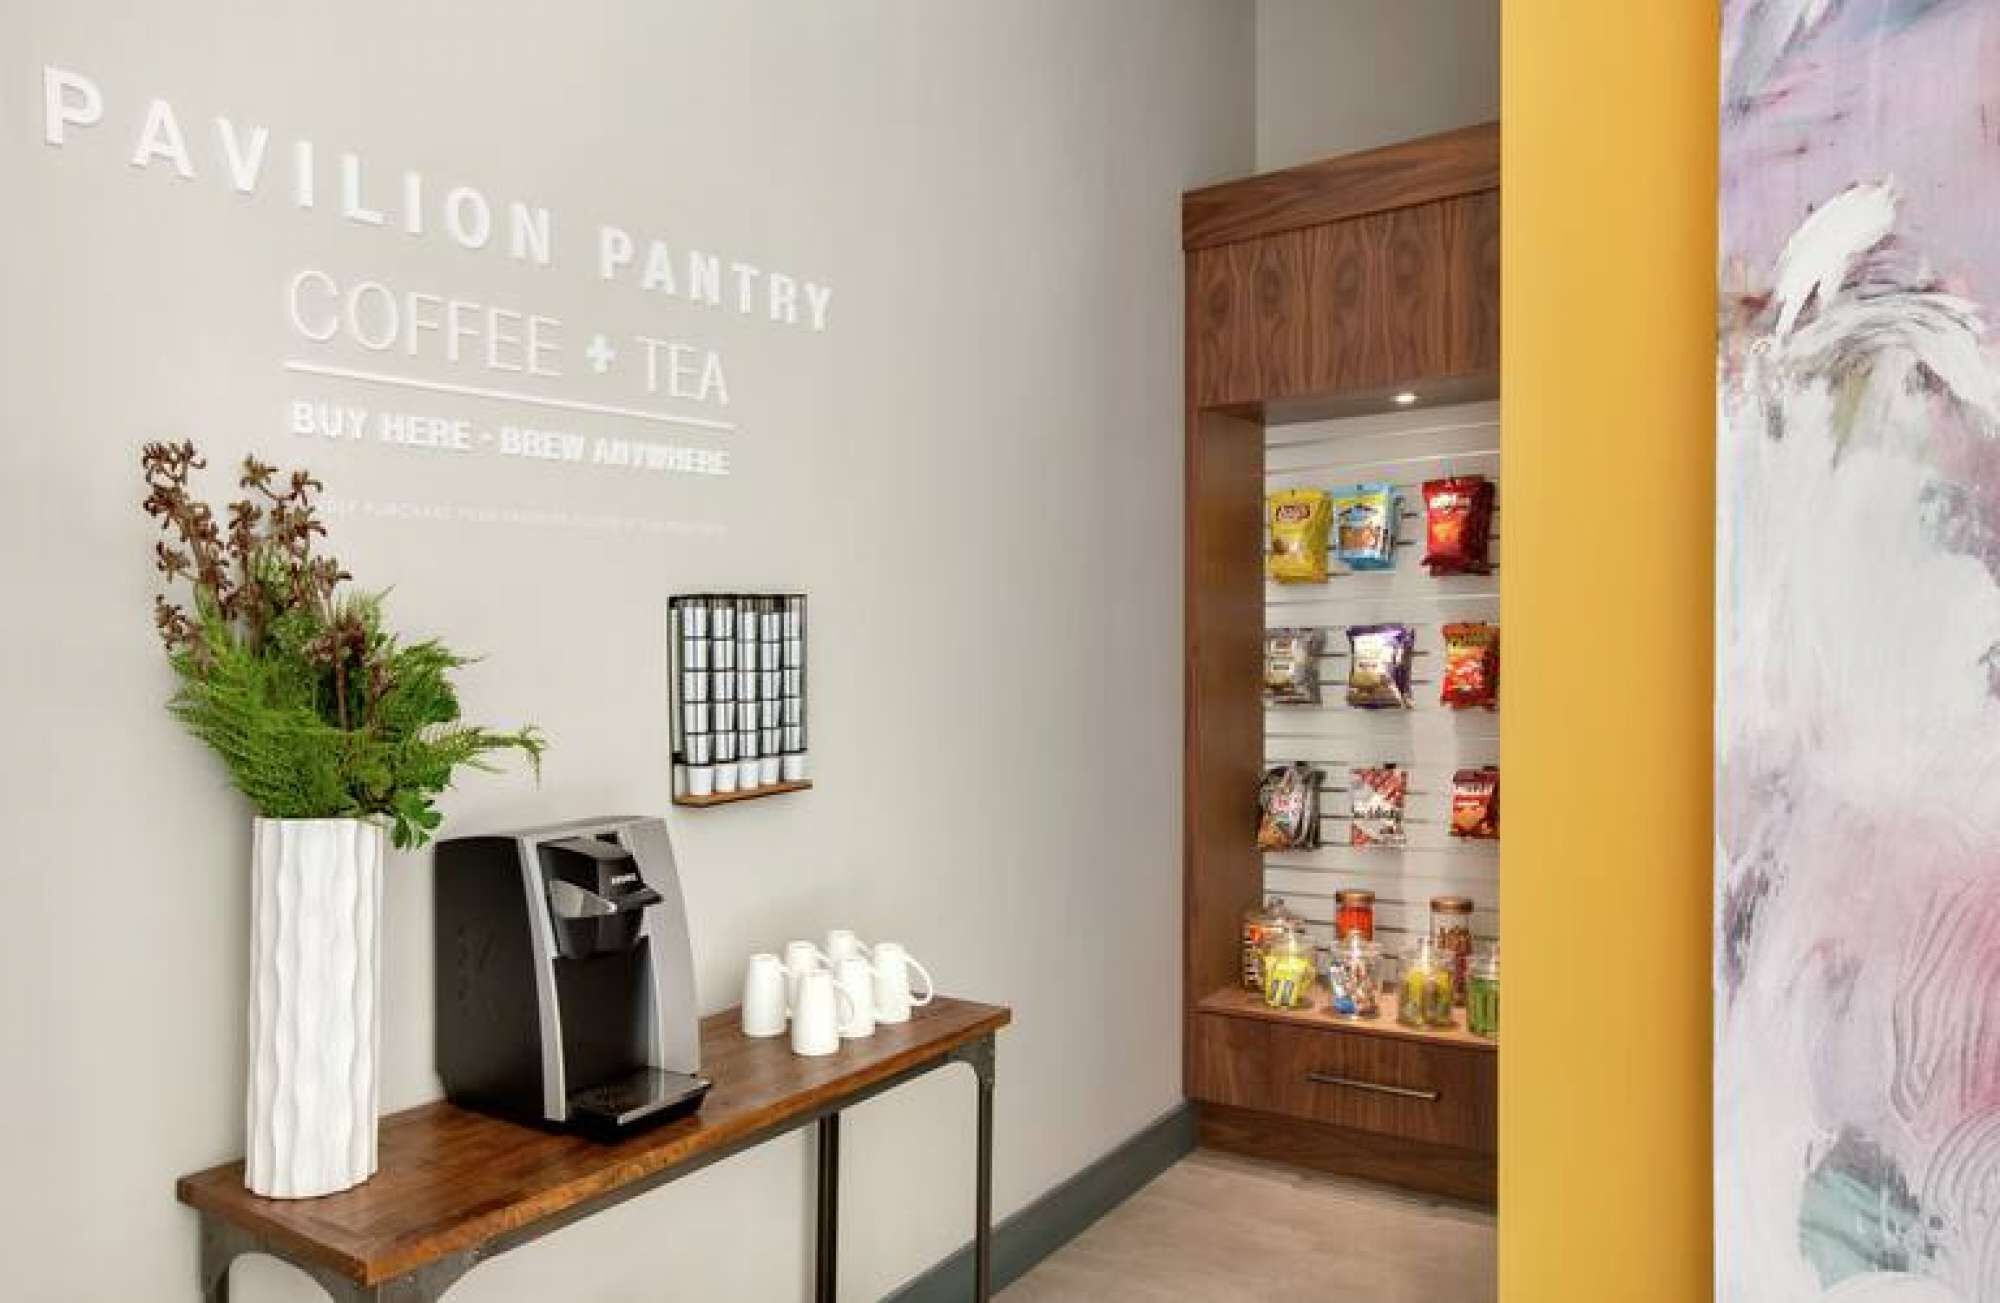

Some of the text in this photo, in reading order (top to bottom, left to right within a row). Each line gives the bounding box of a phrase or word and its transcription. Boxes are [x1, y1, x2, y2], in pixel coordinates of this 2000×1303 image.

[42, 64, 834, 331] PAVILION PANTRY
[289, 269, 563, 377] COFFEE
[635, 335, 729, 406] TEA
[293, 400, 368, 439] BUY
[381, 412, 472, 449] HERE
[499, 425, 585, 460] BREW
[592, 436, 731, 475] ANYWHERE
